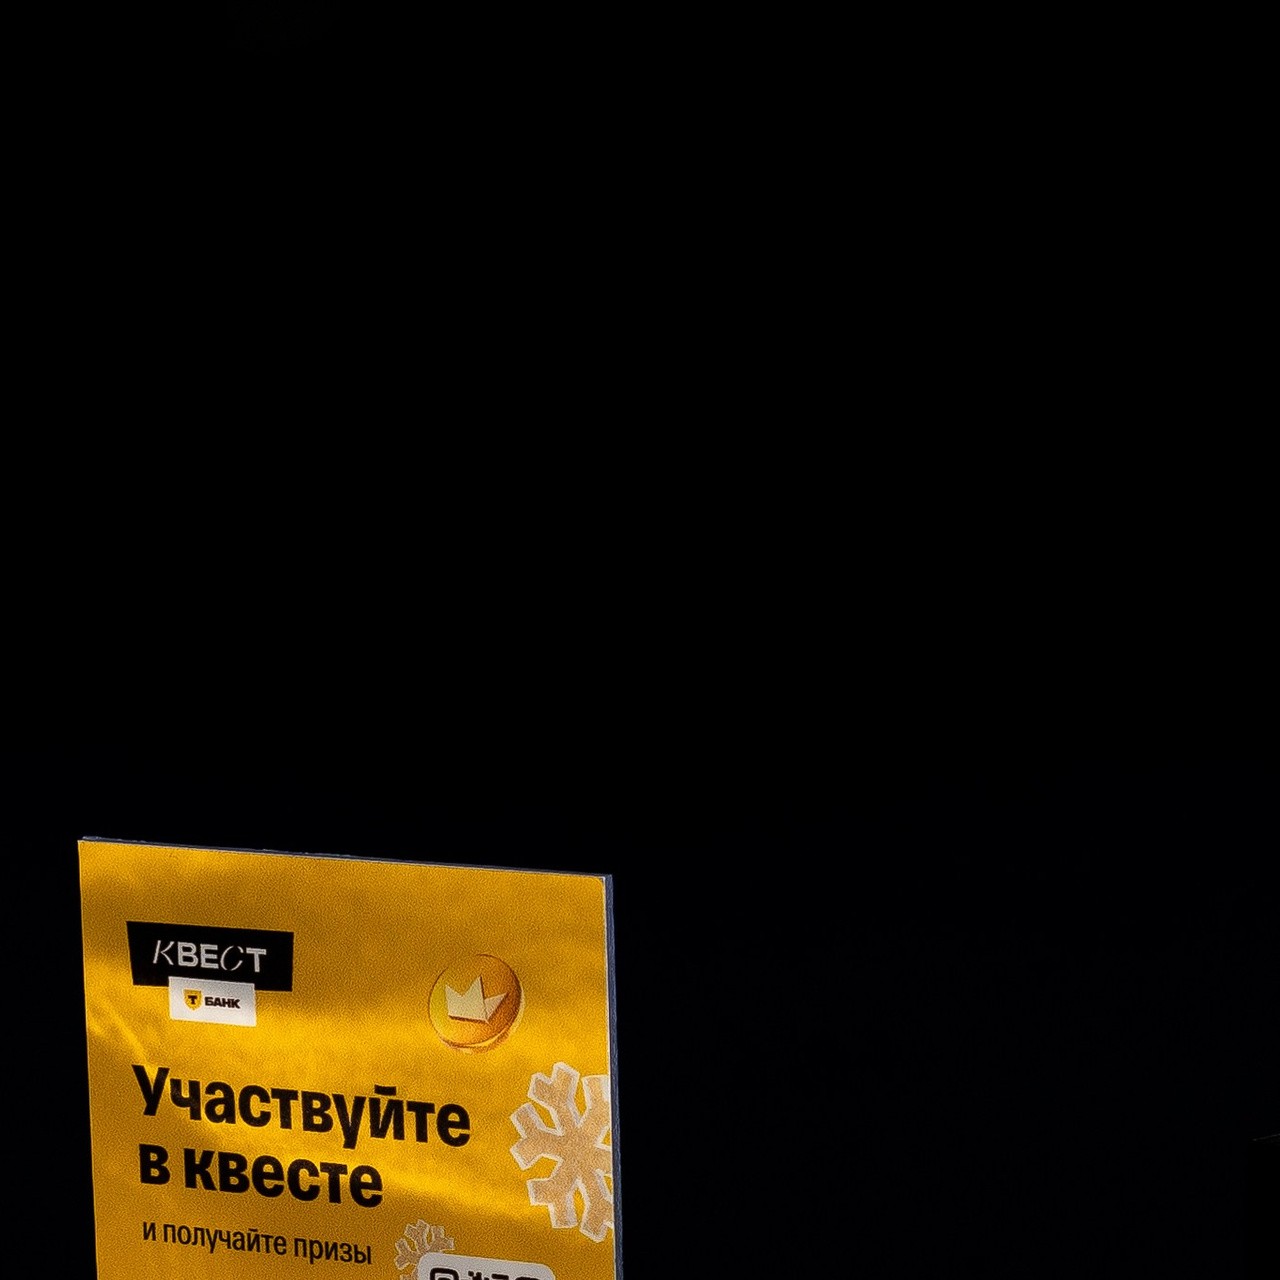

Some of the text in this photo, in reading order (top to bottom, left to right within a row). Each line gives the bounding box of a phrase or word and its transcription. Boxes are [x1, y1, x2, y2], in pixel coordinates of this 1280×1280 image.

[152, 939, 267, 973] КВЕСТ
[204, 996, 240, 1009] БАНК
[131, 1064, 471, 1149] Участвуйте
[138, 1143, 384, 1208] в квесте
[143, 1221, 372, 1265] и получайте призы
